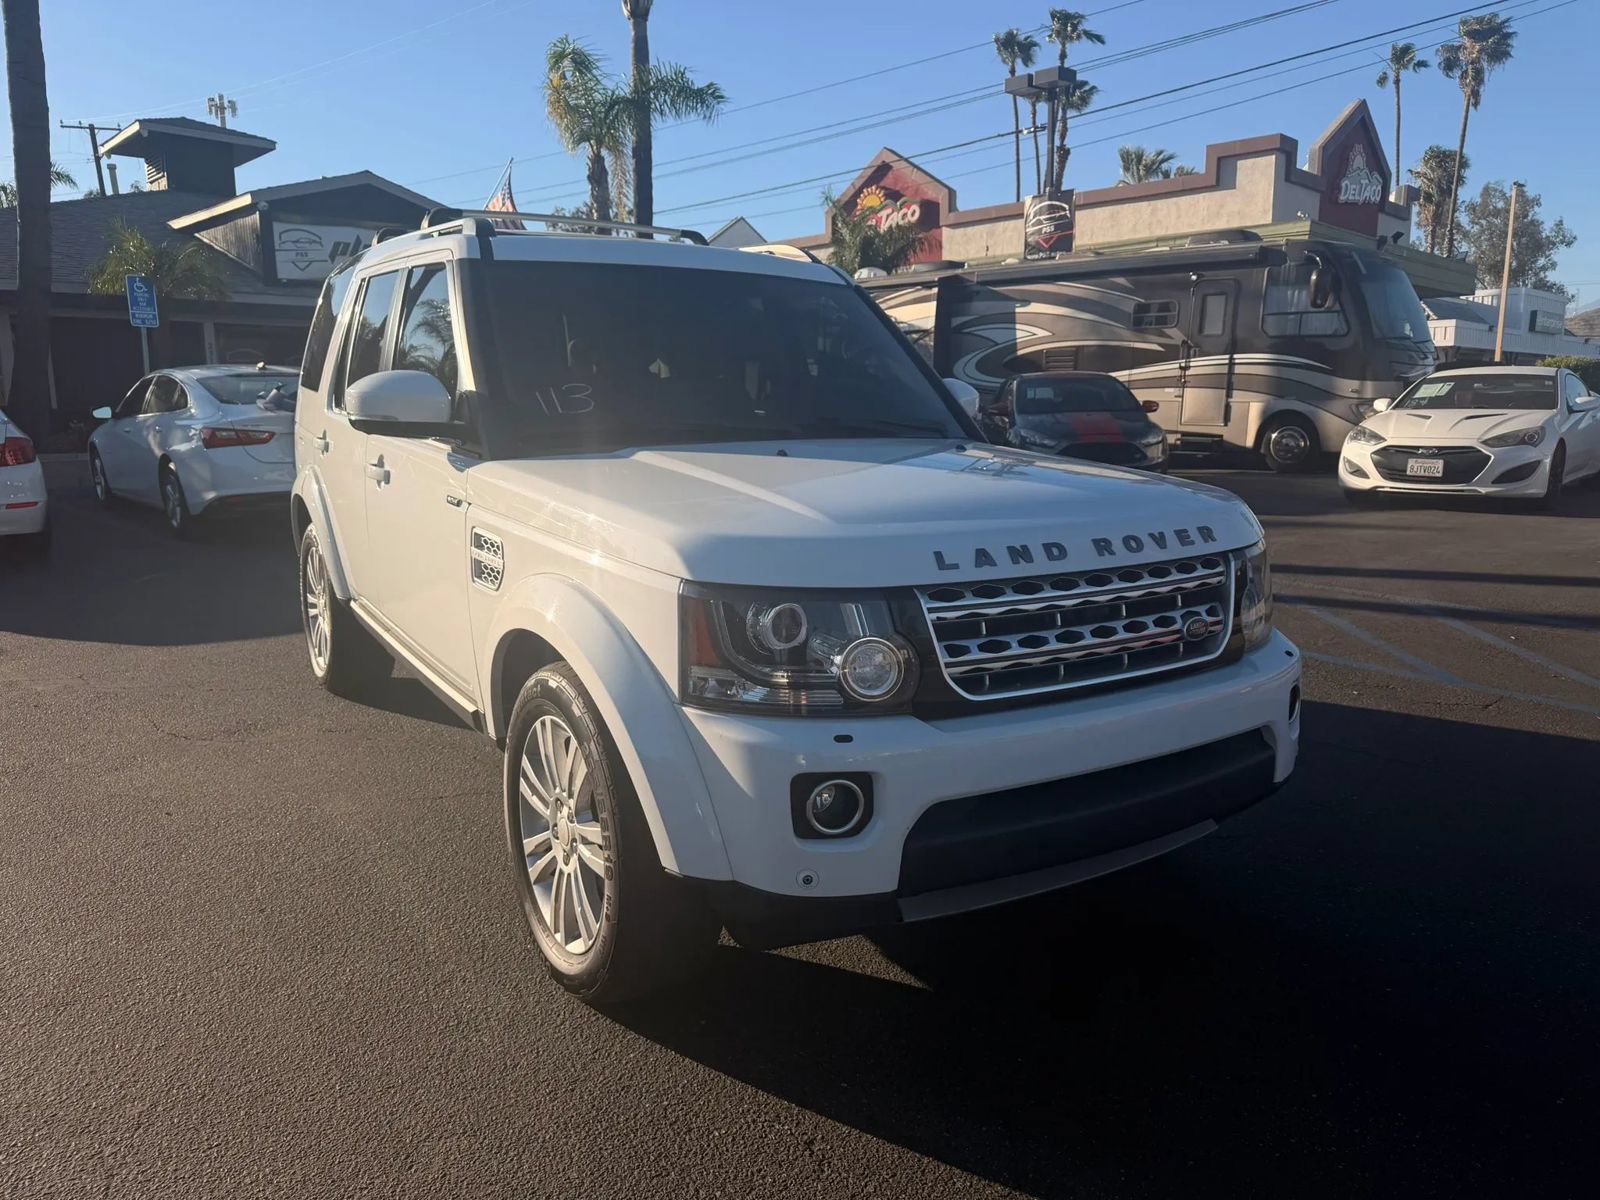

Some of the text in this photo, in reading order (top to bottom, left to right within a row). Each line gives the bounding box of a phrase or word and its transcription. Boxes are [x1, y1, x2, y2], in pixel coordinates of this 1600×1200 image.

[1360, 179, 1382, 202] TACO
[877, 204, 920, 234] TACO
[535, 383, 595, 416] 113
[933, 525, 1218, 571] LAND ROVER
